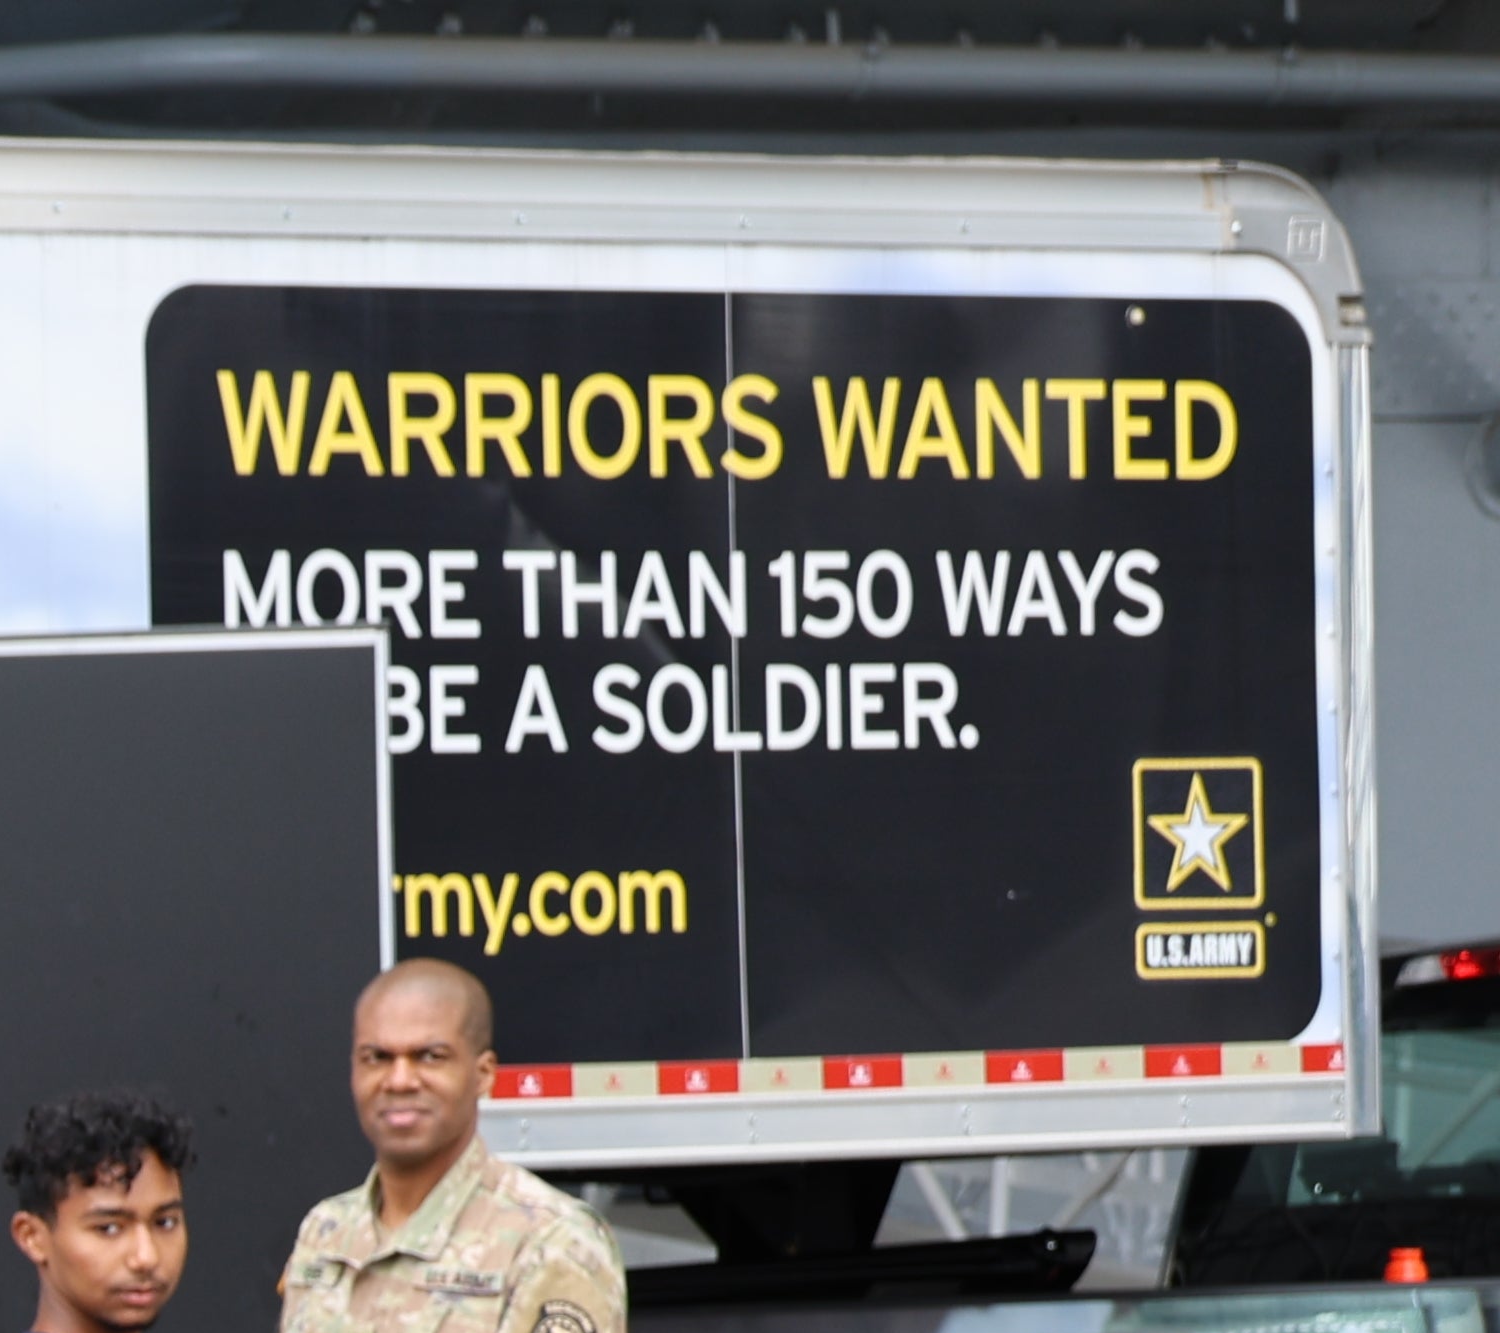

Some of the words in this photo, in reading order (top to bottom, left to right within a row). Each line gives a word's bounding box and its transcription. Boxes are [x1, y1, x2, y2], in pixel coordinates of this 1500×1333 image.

[217, 369, 784, 480] WARRIORS
[813, 375, 1239, 482] WANTED
[222, 547, 482, 640] MORE
[502, 548, 748, 639] THAN
[770, 548, 915, 639] 150
[938, 549, 1165, 638] WAYS
[506, 665, 569, 753] A
[592, 661, 981, 753] SOLDIER.
[392, 868, 688, 957] my.com
[1145, 931, 1254, 968] U.S.ARMY
